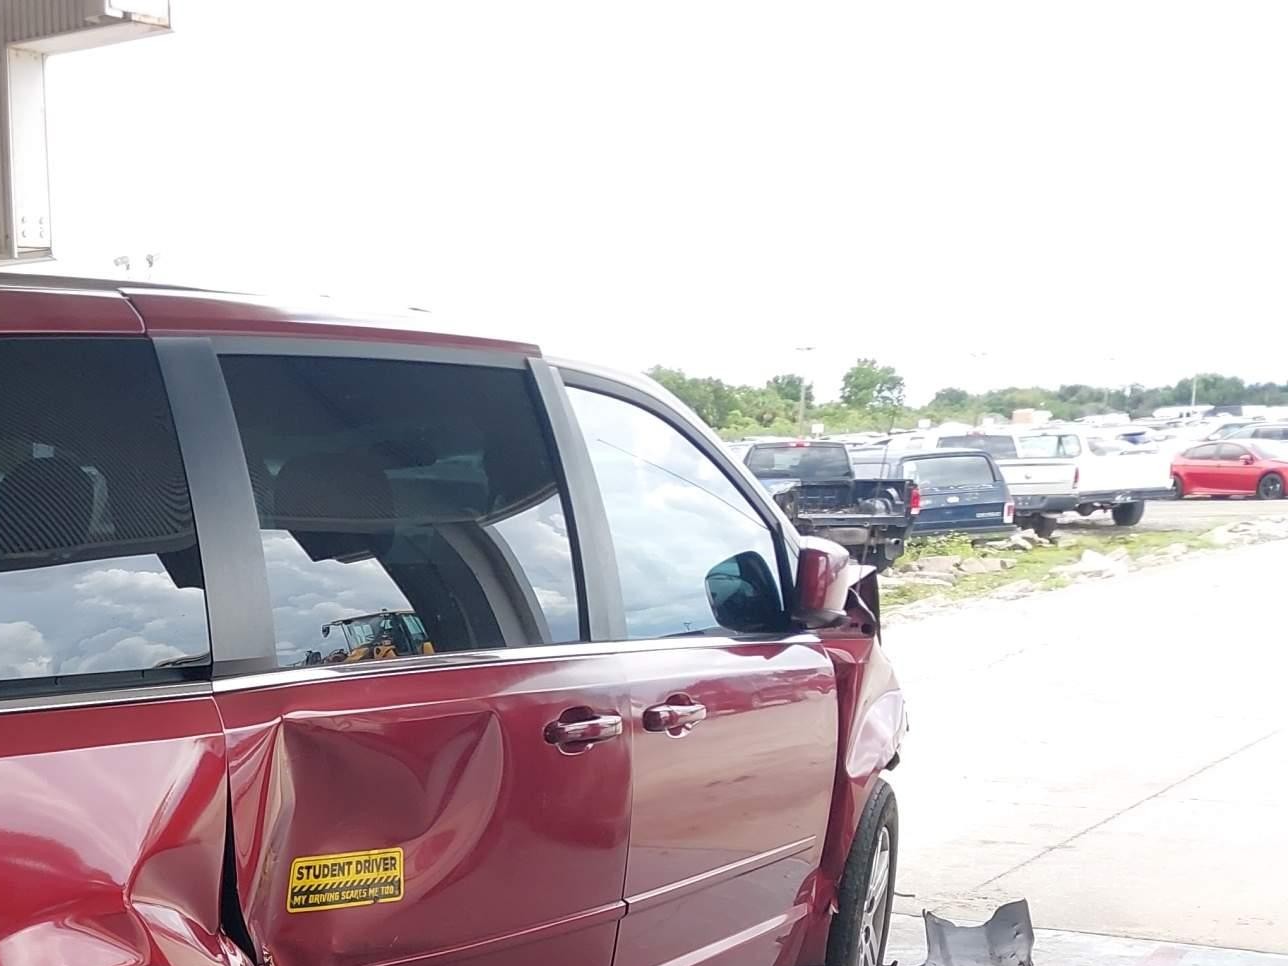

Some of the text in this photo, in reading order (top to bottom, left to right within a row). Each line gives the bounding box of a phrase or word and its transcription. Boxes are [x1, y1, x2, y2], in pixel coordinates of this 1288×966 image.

[296, 856, 397, 881] STUDENT DRIVER
[293, 885, 394, 906] MY DRIVING SCARES ME TOO
